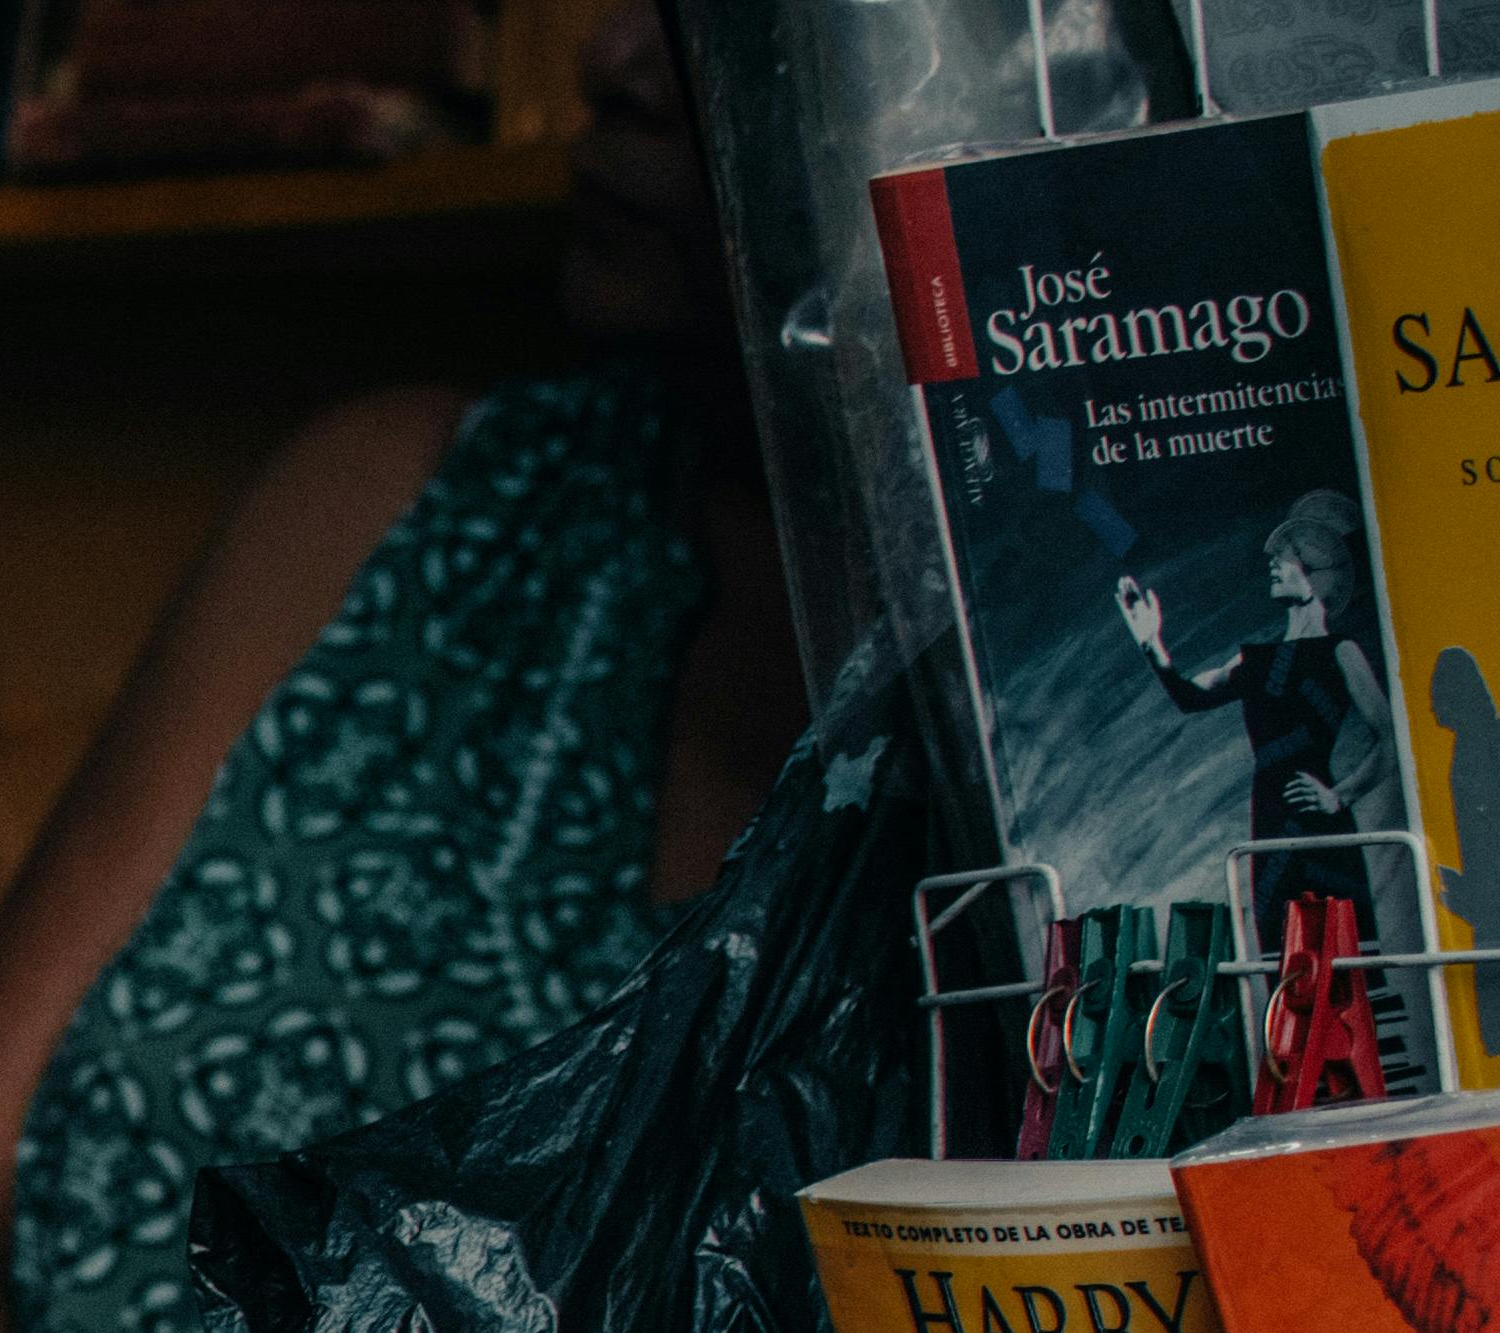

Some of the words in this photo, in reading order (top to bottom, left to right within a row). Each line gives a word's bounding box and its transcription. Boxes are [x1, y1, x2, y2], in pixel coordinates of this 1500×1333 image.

[1020, 252, 1112, 321] José
[929, 274, 958, 369] BIBLIOTECA
[987, 289, 1311, 376] Saramago
[1085, 397, 1132, 430] Las
[1092, 435, 1130, 466] de
[1135, 431, 1161, 459] la
[1170, 421, 1275, 457] muerte
[843, 1220, 893, 1241] TEXTO
[897, 1223, 990, 1244] COMPLETO
[993, 1223, 1023, 1243] DE
[1025, 1222, 1052, 1242] LA
[1057, 1219, 1116, 1240] OBRA
[1121, 1217, 1150, 1238] DE
